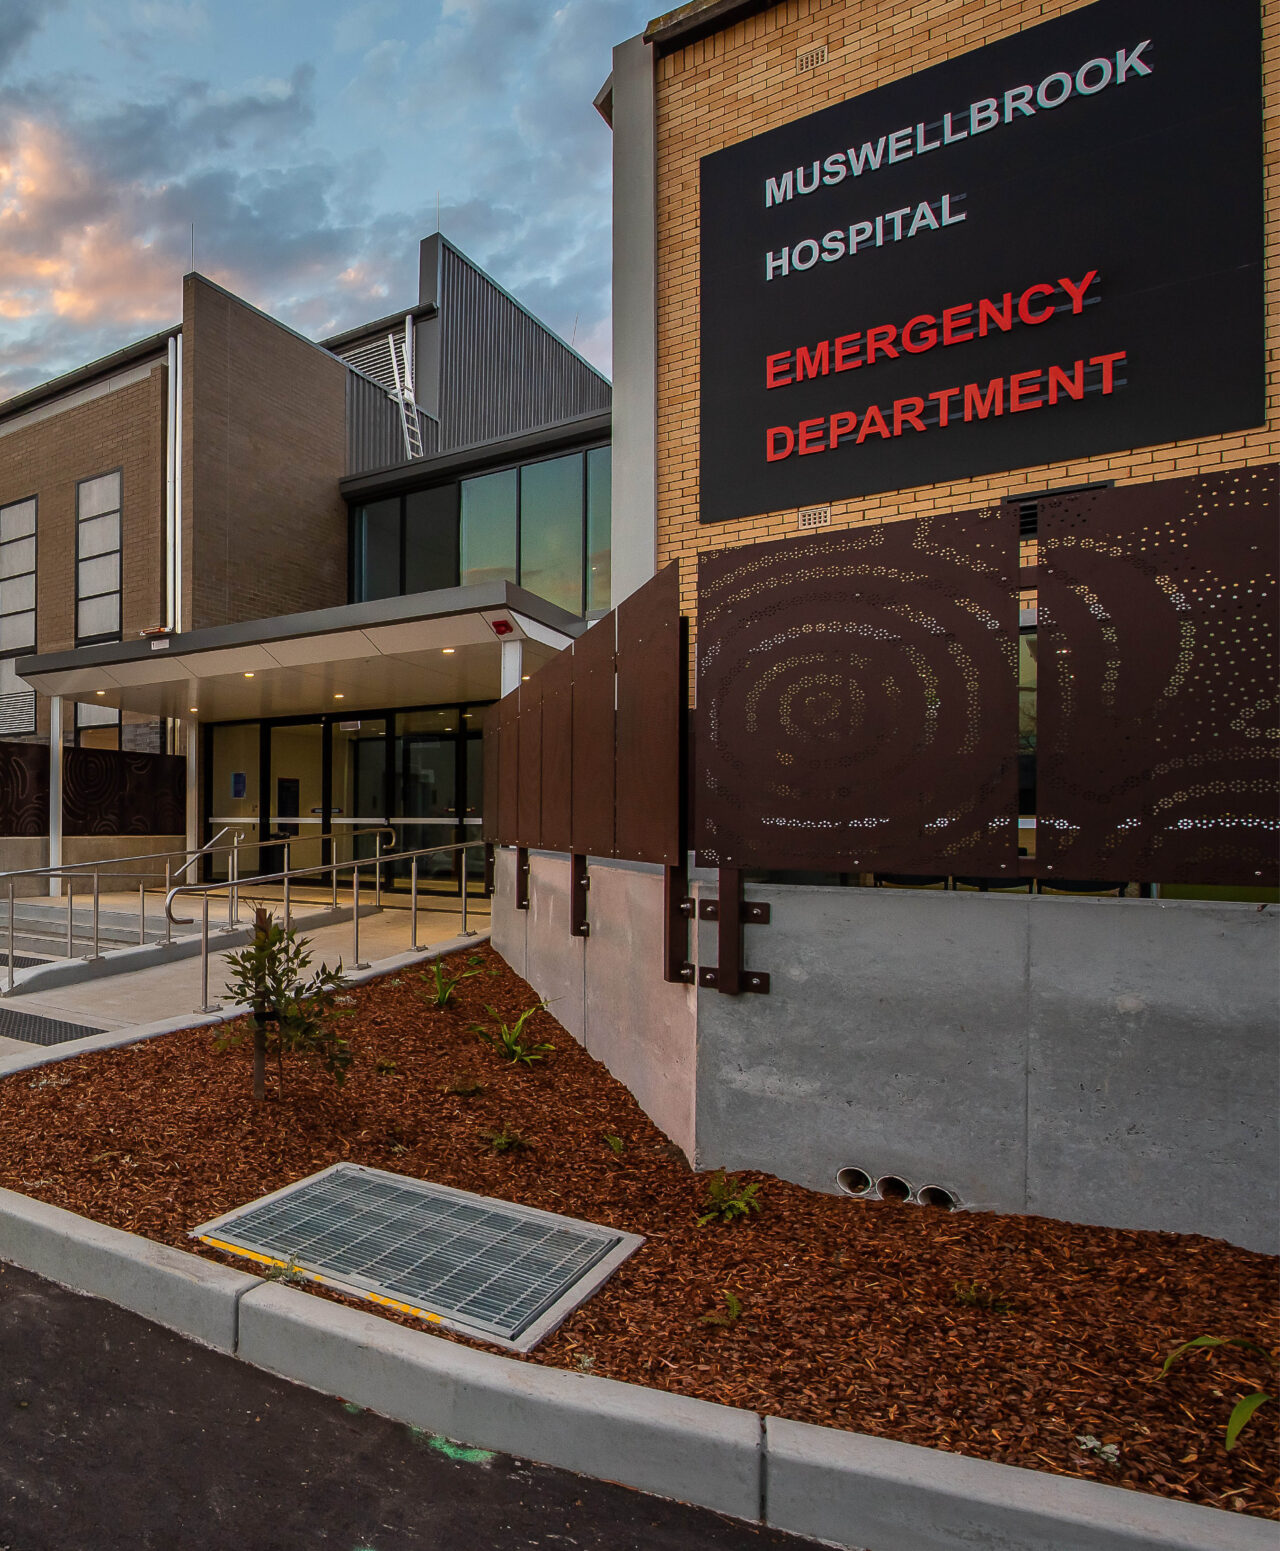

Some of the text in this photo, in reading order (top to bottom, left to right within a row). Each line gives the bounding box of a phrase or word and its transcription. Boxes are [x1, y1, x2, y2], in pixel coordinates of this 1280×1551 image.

[765, 39, 1152, 208] MUSWELLBROOK
[766, 194, 966, 281] HOSPITAL
[766, 270, 1098, 389] EMERGENCY
[766, 350, 1127, 462] DEPARTMENT
